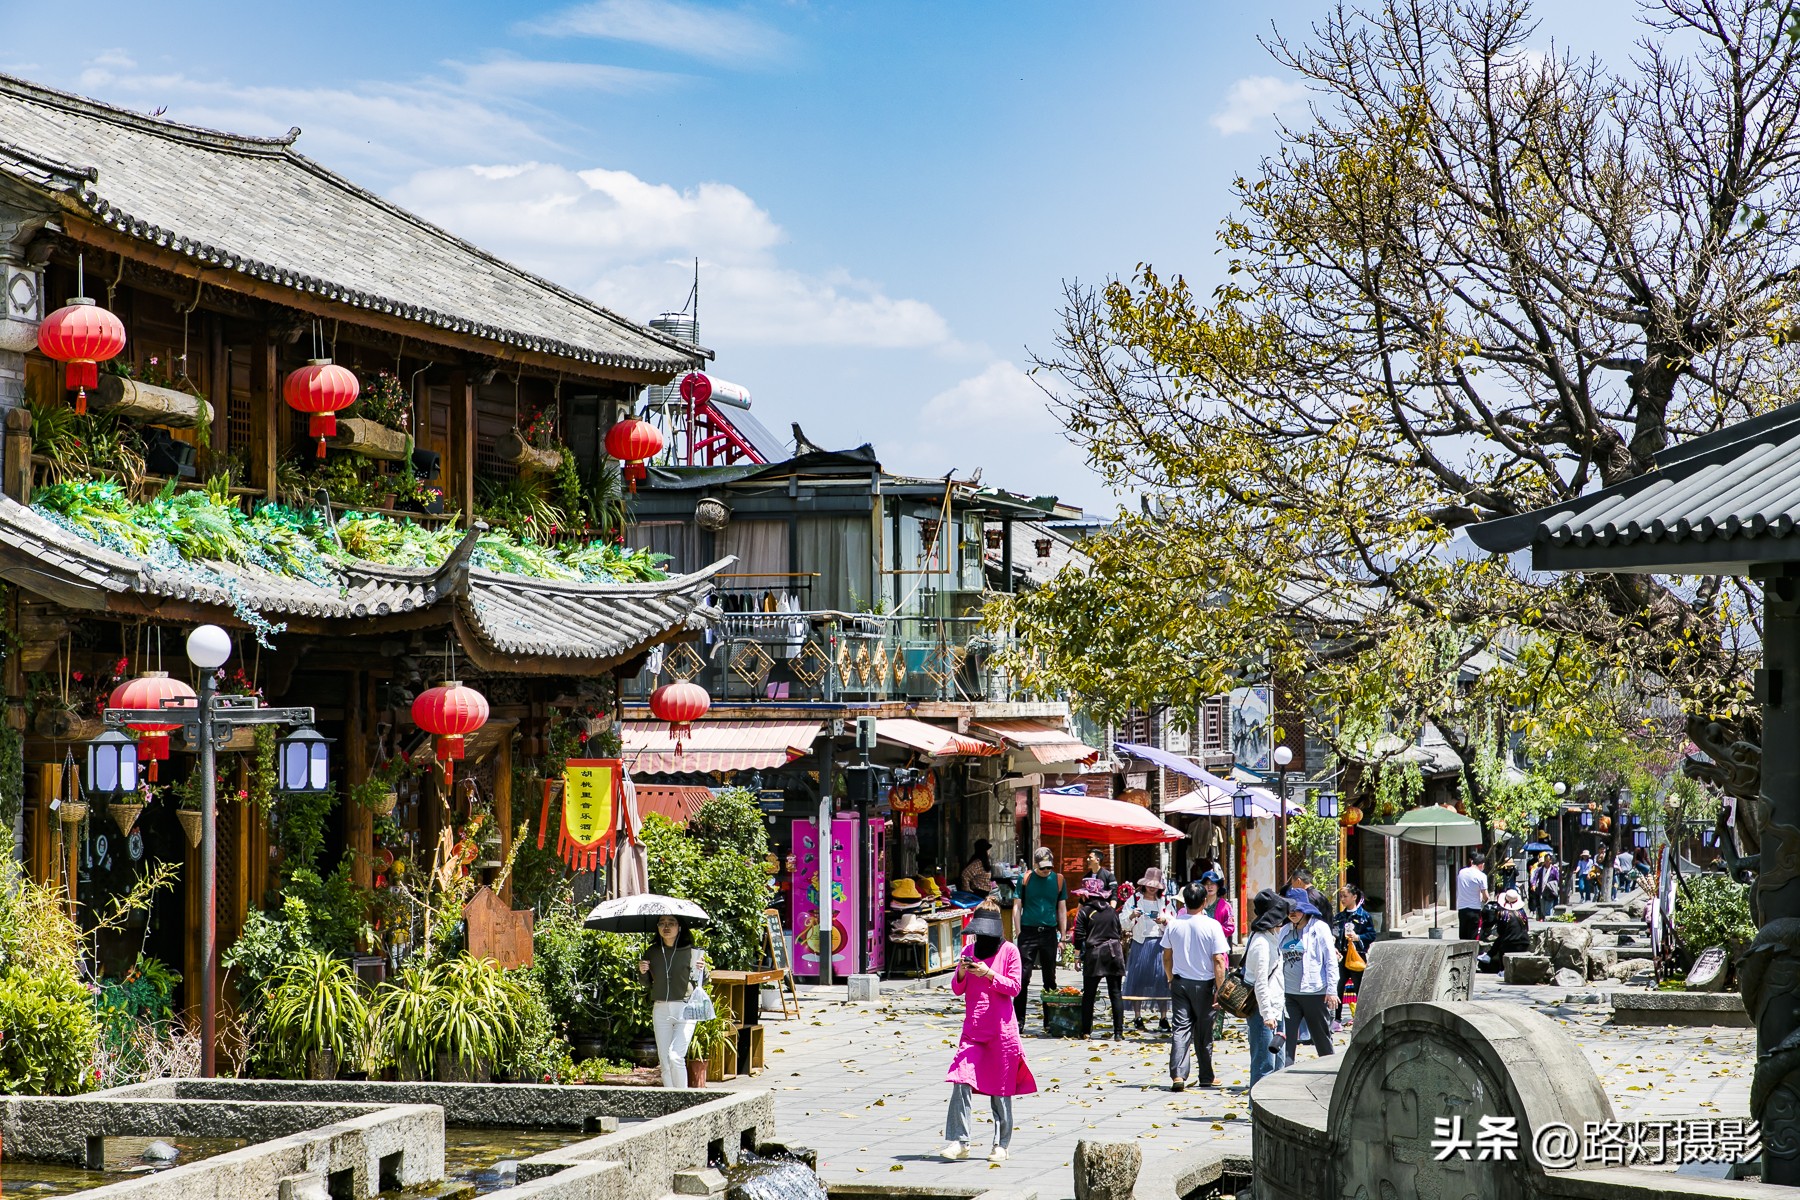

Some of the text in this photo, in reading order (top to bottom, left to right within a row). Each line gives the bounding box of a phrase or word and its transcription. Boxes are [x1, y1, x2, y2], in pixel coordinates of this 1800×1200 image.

[580, 770, 593, 841] 胡桃里音乐酒馆
